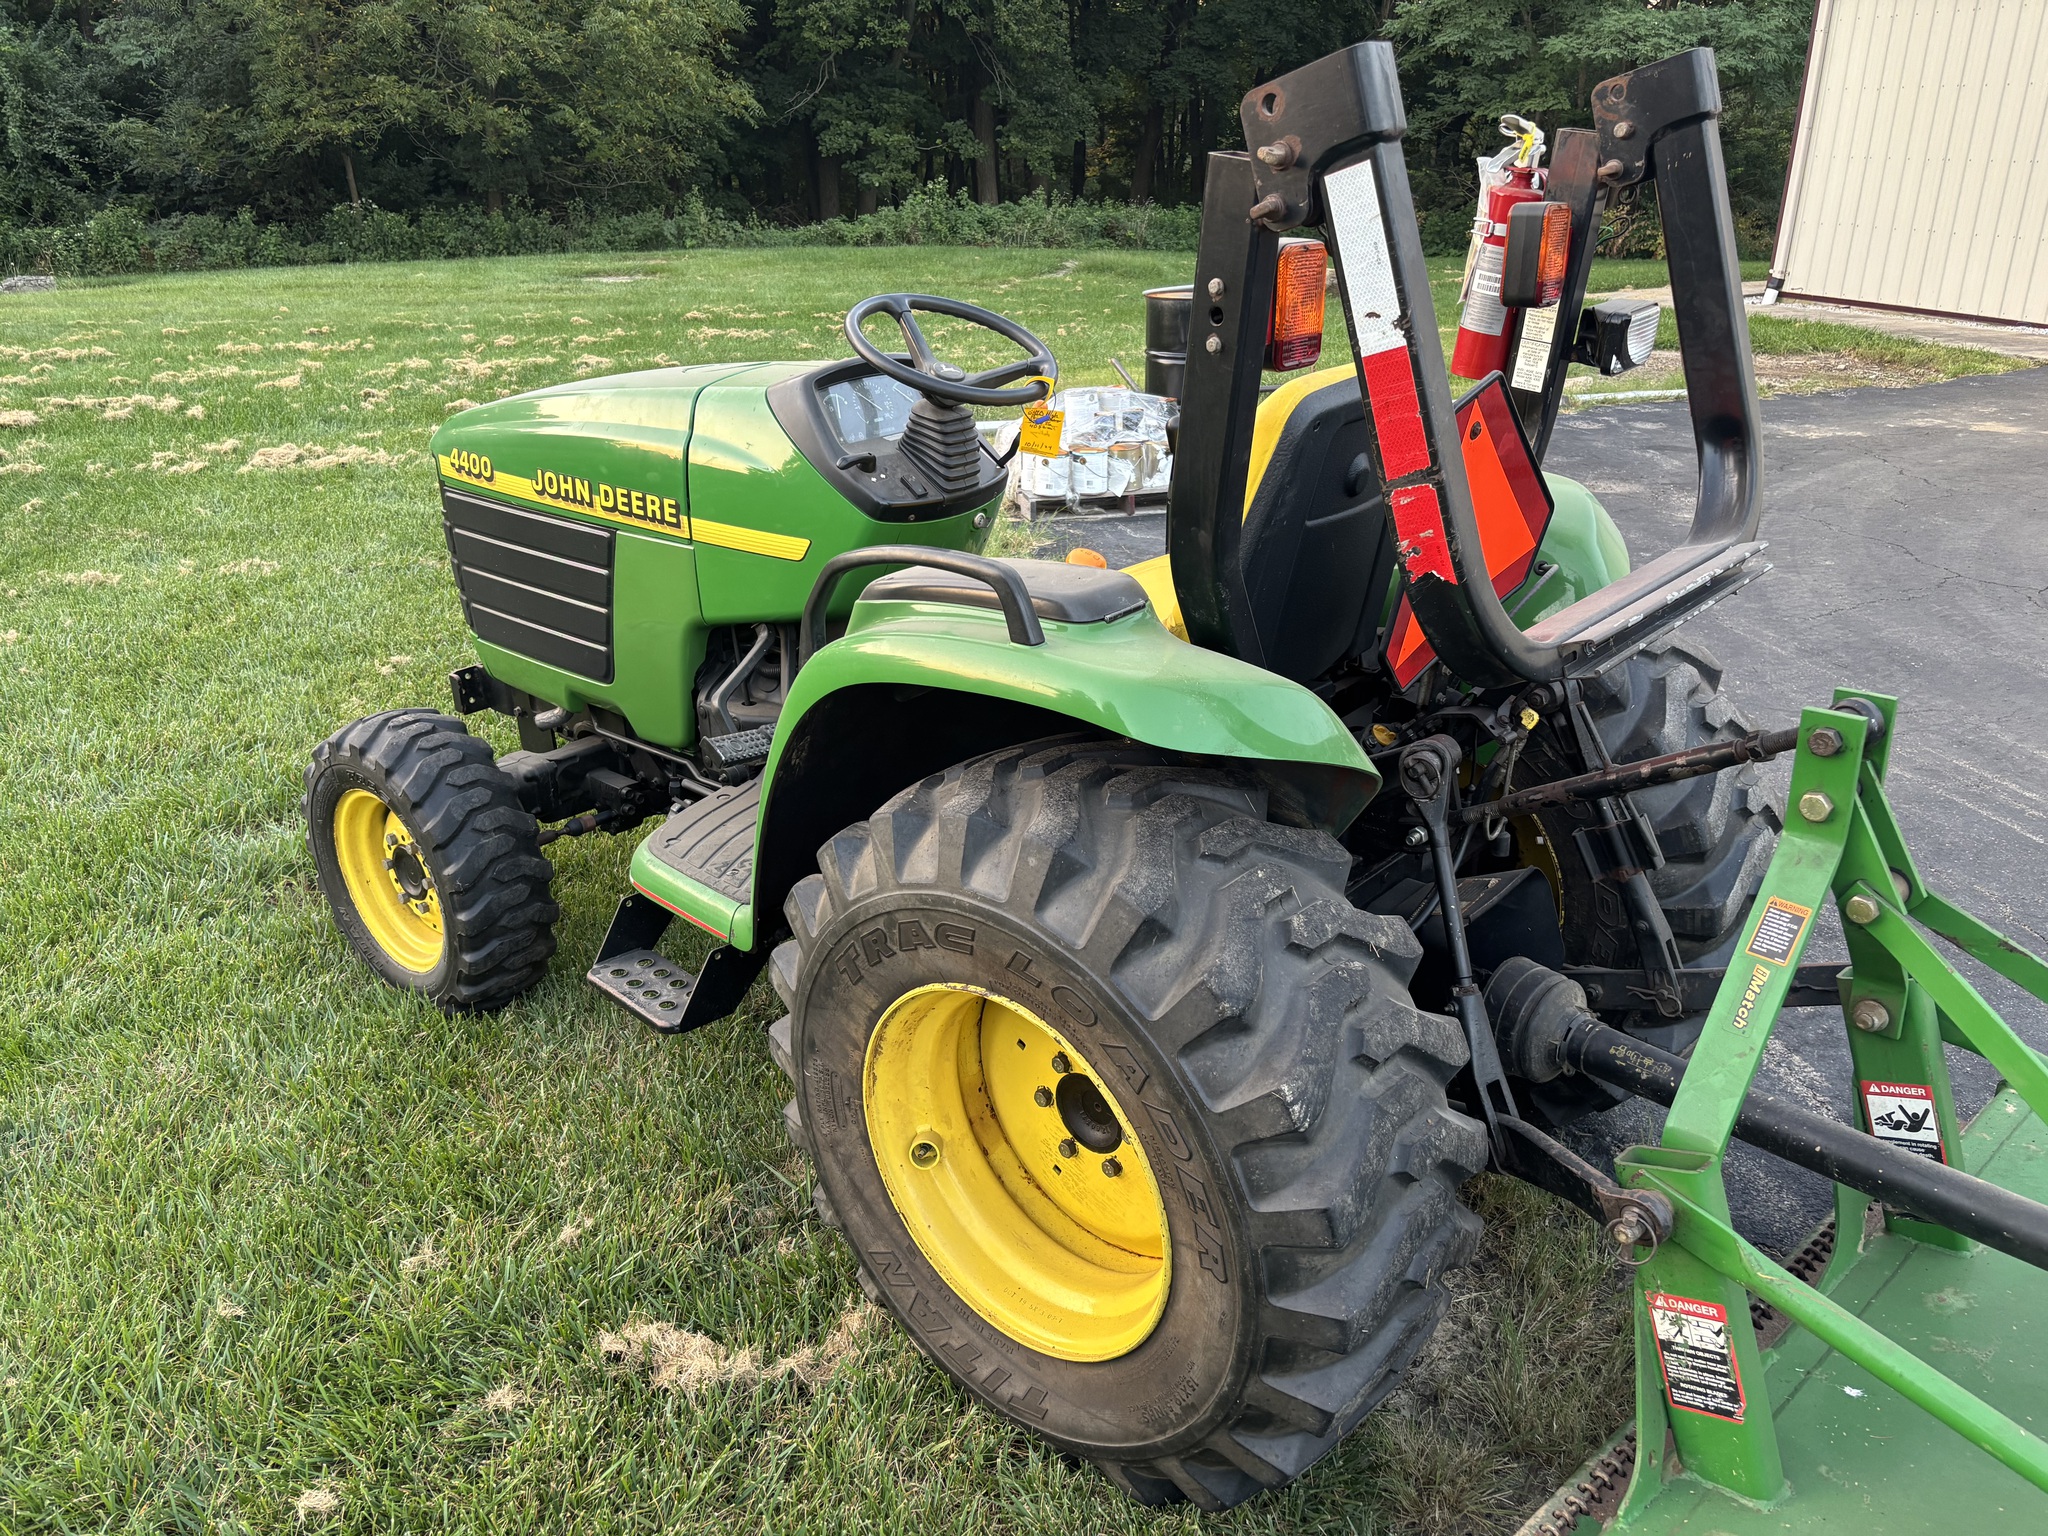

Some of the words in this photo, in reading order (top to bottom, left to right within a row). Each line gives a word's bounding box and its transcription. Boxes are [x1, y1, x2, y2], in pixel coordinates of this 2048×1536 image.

[450, 448, 493, 481] 4400
[531, 469, 594, 508] JOHN
[599, 483, 681, 529] DEERE
[1777, 902, 1810, 916] WARNING
[834, 918, 976, 984] TRAC
[1005, 949, 1230, 1285] LOADER
[1881, 1085, 1926, 1096] DANGER
[1668, 1299, 1719, 1317] DANGER
[869, 1249, 1051, 1421] TITAN
